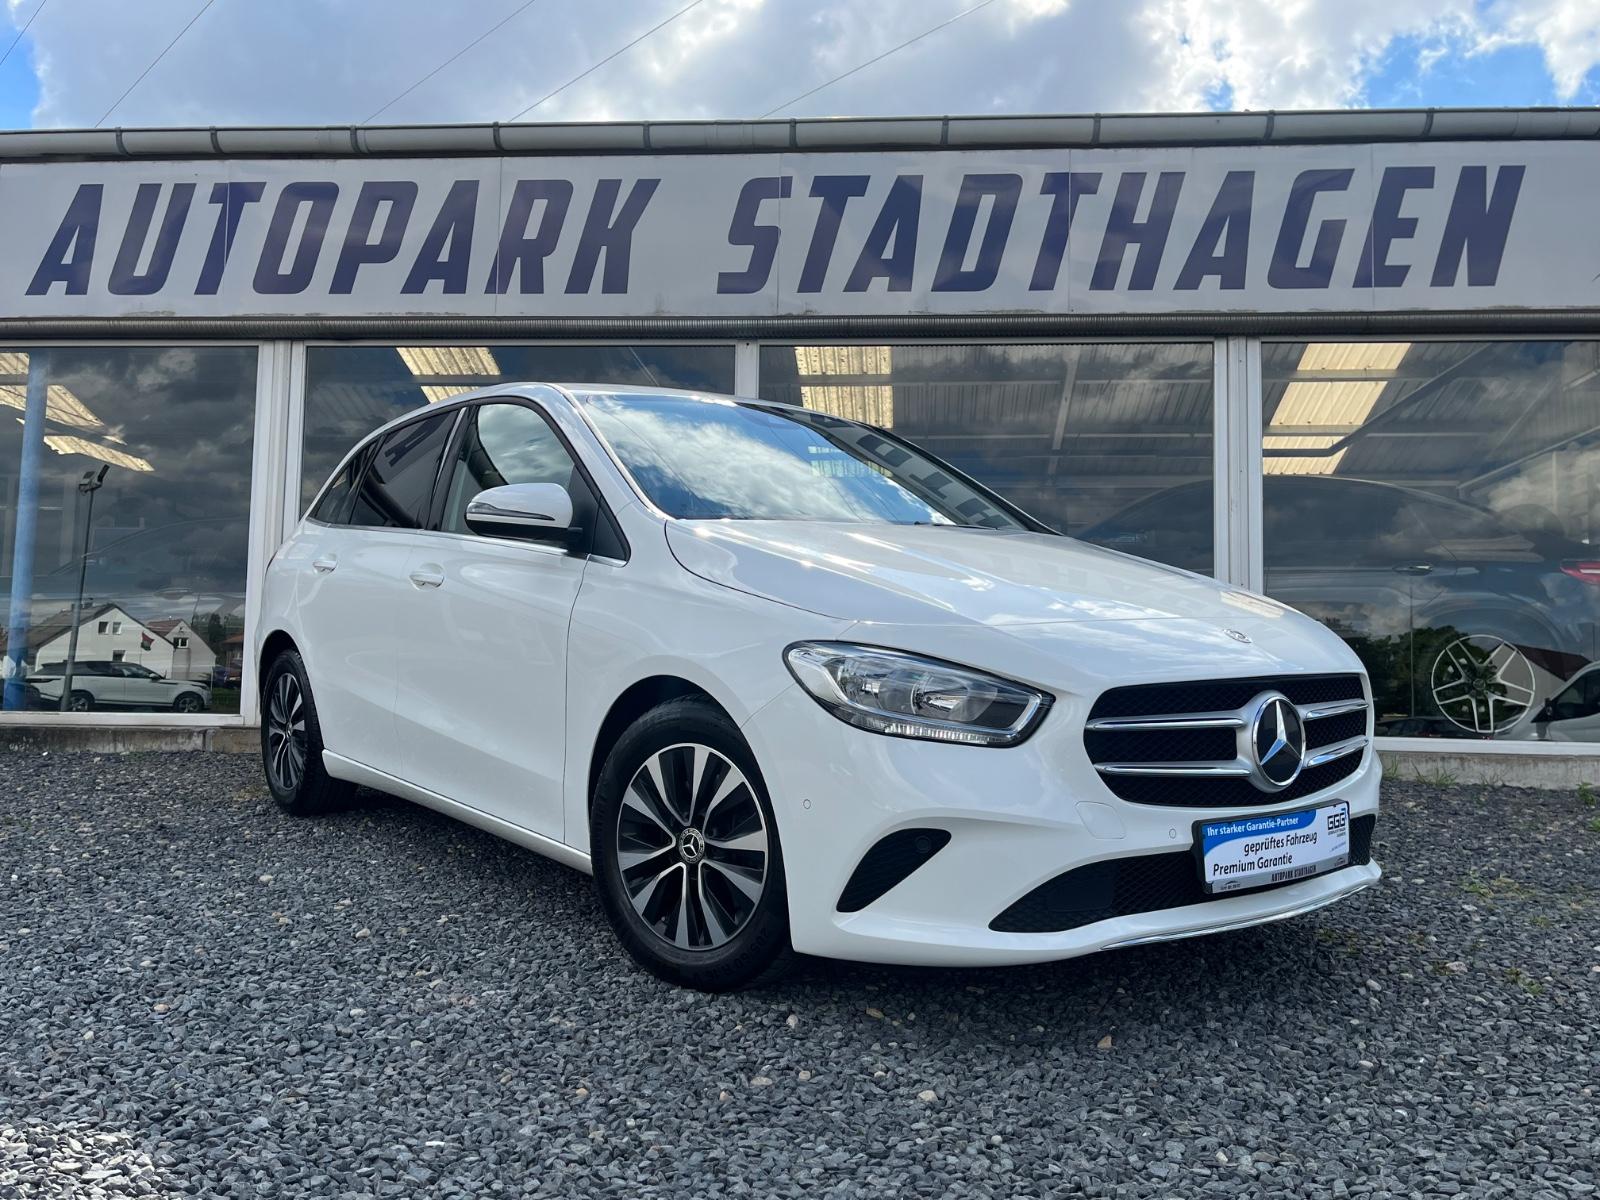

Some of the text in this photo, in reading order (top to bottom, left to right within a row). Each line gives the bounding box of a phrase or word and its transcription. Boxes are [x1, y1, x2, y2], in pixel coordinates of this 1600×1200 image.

[24, 164, 1526, 296] AUTOPARK STADTHAGEN
[1207, 817, 1299, 837] Ihr starker Garantie-Partner
[1244, 832, 1317, 856] geprüftes Fahrzeug
[1213, 852, 1293, 876] Premium Garantie
